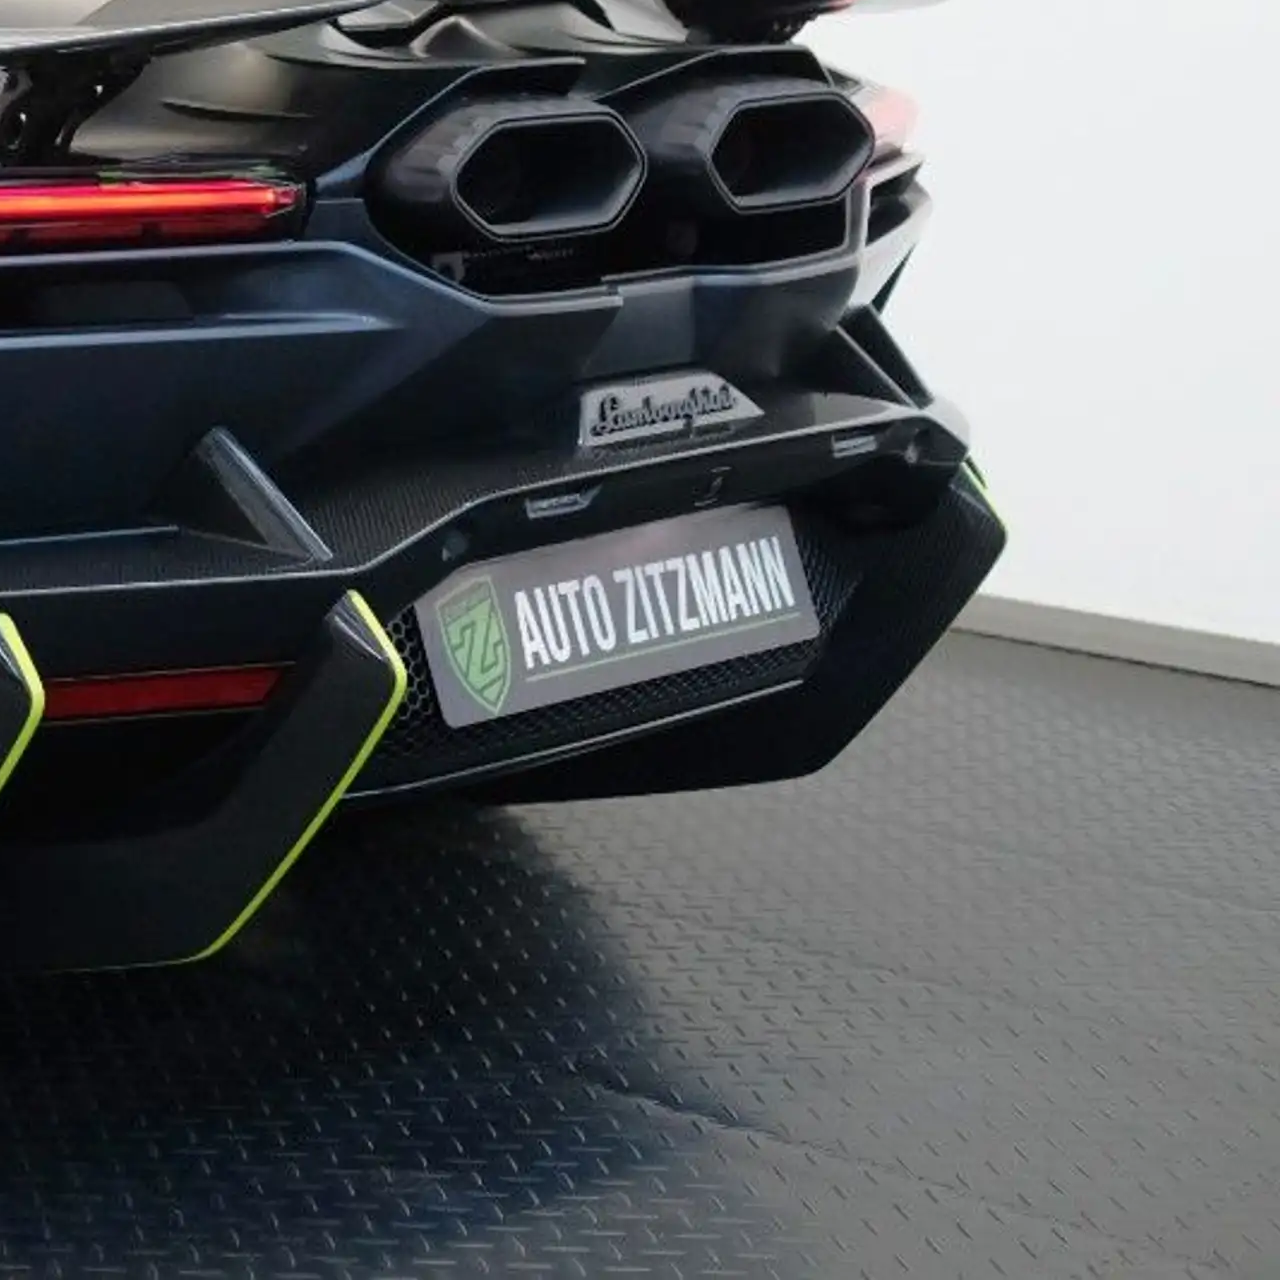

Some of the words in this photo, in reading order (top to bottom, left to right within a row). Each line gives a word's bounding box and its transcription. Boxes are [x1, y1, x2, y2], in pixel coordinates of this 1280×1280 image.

[590, 384, 737, 436] Lamborghini
[513, 574, 618, 670] AUTO
[611, 535, 796, 645] ZITZMANN
